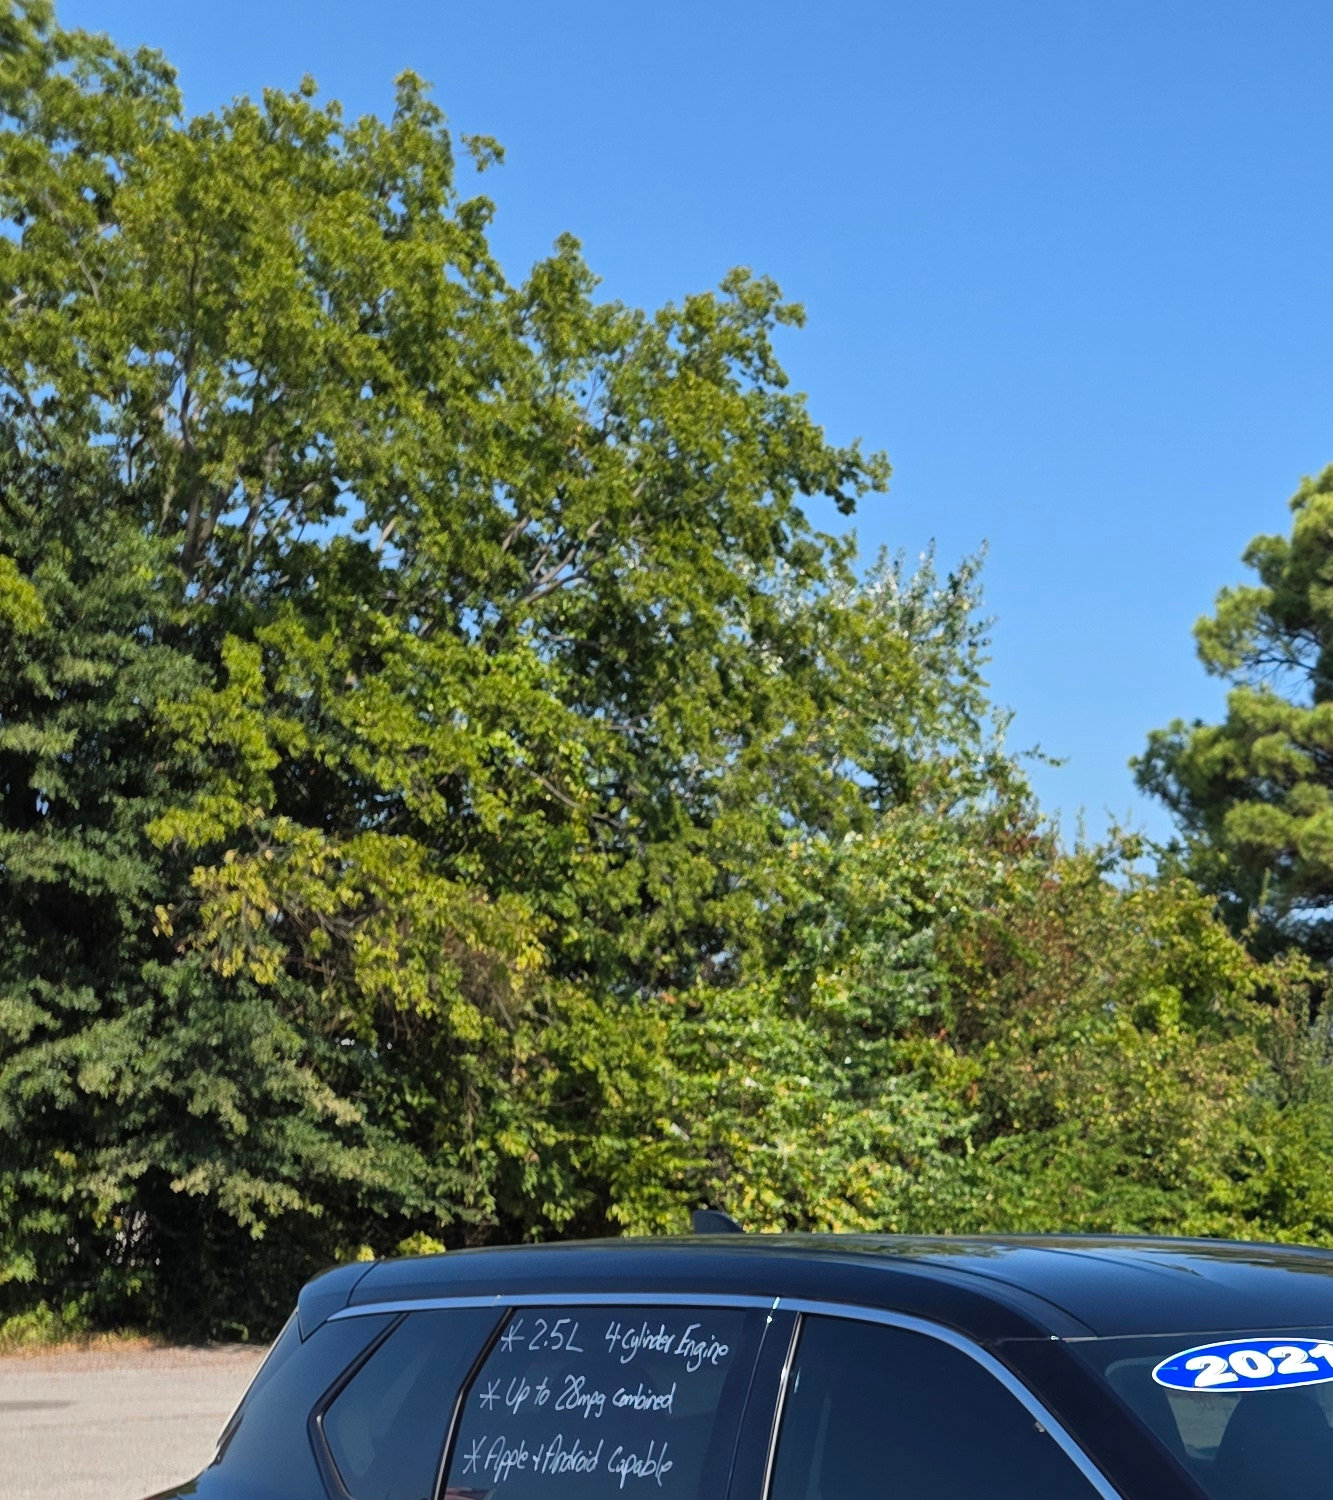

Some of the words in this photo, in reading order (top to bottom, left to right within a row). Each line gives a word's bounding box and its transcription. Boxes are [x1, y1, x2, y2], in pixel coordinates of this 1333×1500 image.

[528, 1318, 583, 1353] 2.5L
[674, 1323, 729, 1373] Engine
[505, 1377, 530, 1415] Up
[535, 1376, 550, 1406] to
[484, 1435, 529, 1483] Apple
[541, 1433, 604, 1474] Android
